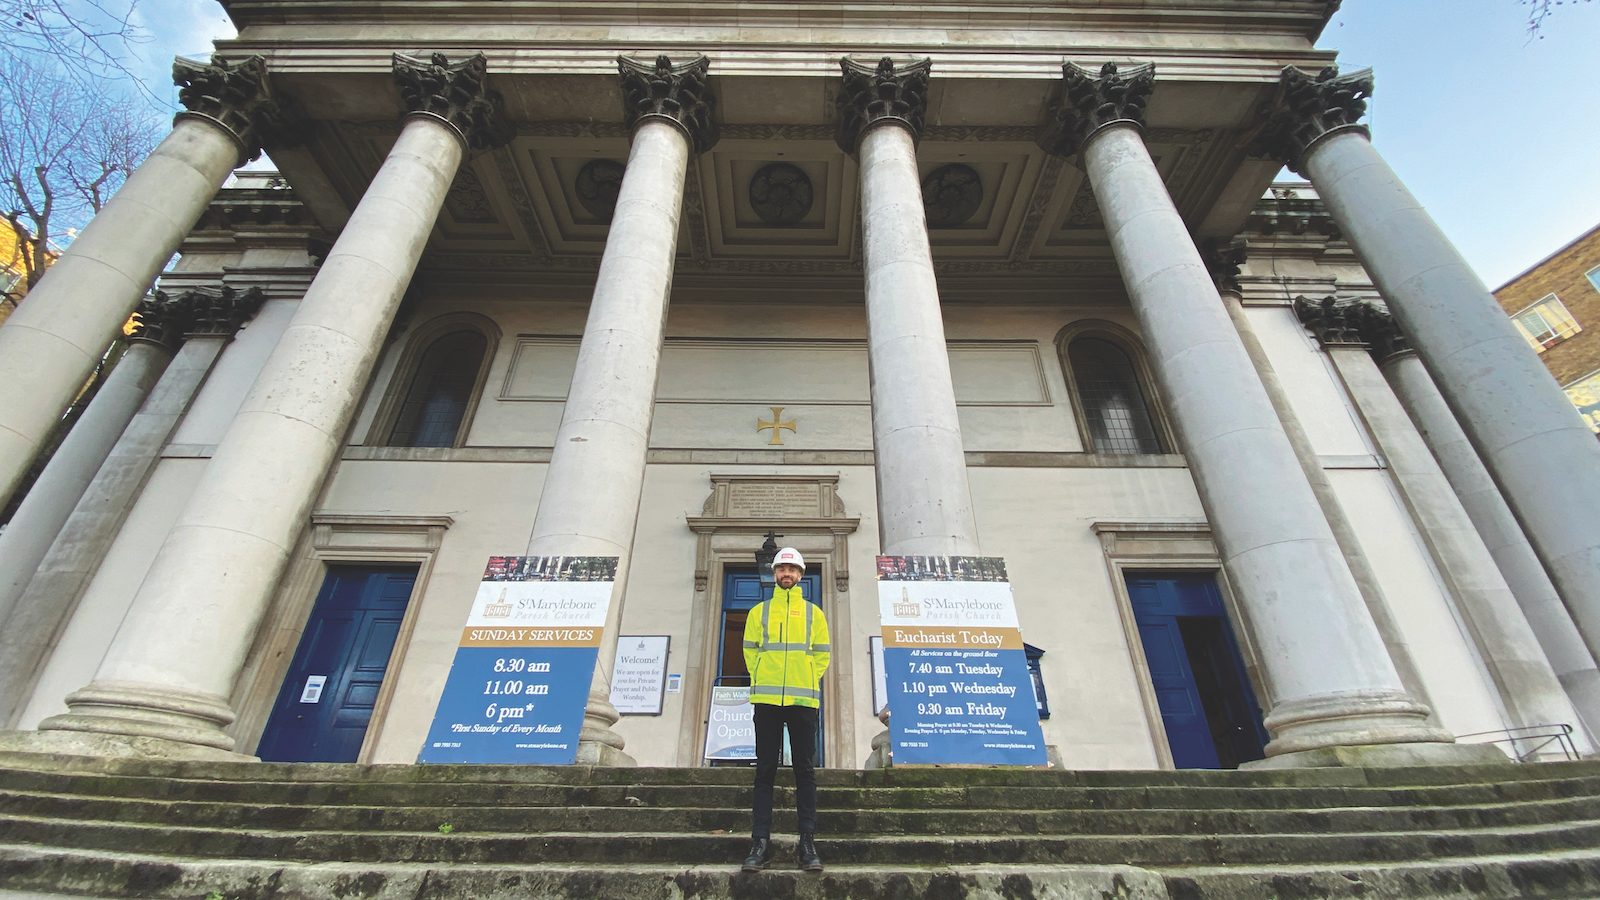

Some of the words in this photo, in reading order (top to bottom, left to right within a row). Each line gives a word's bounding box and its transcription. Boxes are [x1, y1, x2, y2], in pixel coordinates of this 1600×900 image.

[515, 611, 548, 619] Parish
[554, 611, 590, 619] Church
[926, 611, 959, 620] Parish
[965, 611, 1001, 620] Church
[469, 629, 527, 641] SUNDAY
[528, 629, 593, 641] SERVICES
[894, 630, 956, 643] Eucharist
[959, 631, 1003, 649] Today
[494, 658, 525, 672] 8.30
[527, 662, 550, 672] am
[621, 656, 659, 664] Welcome!
[909, 662, 932, 674] 7.40
[935, 666, 953, 674] am
[955, 663, 1003, 678] Tuesday
[483, 680, 523, 695] 11.00
[525, 684, 548, 695] am
[613, 686, 629, 694] Prayer
[903, 682, 925, 693] 1.10
[928, 684, 947, 697] pm
[950, 682, 1016, 698] Wednesday
[486, 703, 497, 718] 6
[918, 703, 942, 715] 9.30
[945, 707, 963, 715] am
[966, 703, 1007, 719] Friday
[471, 724, 502, 735] Sunday
[502, 724, 513, 733] of
[511, 724, 535, 735] Every
[535, 724, 562, 733] Month
[717, 725, 752, 739] Open
